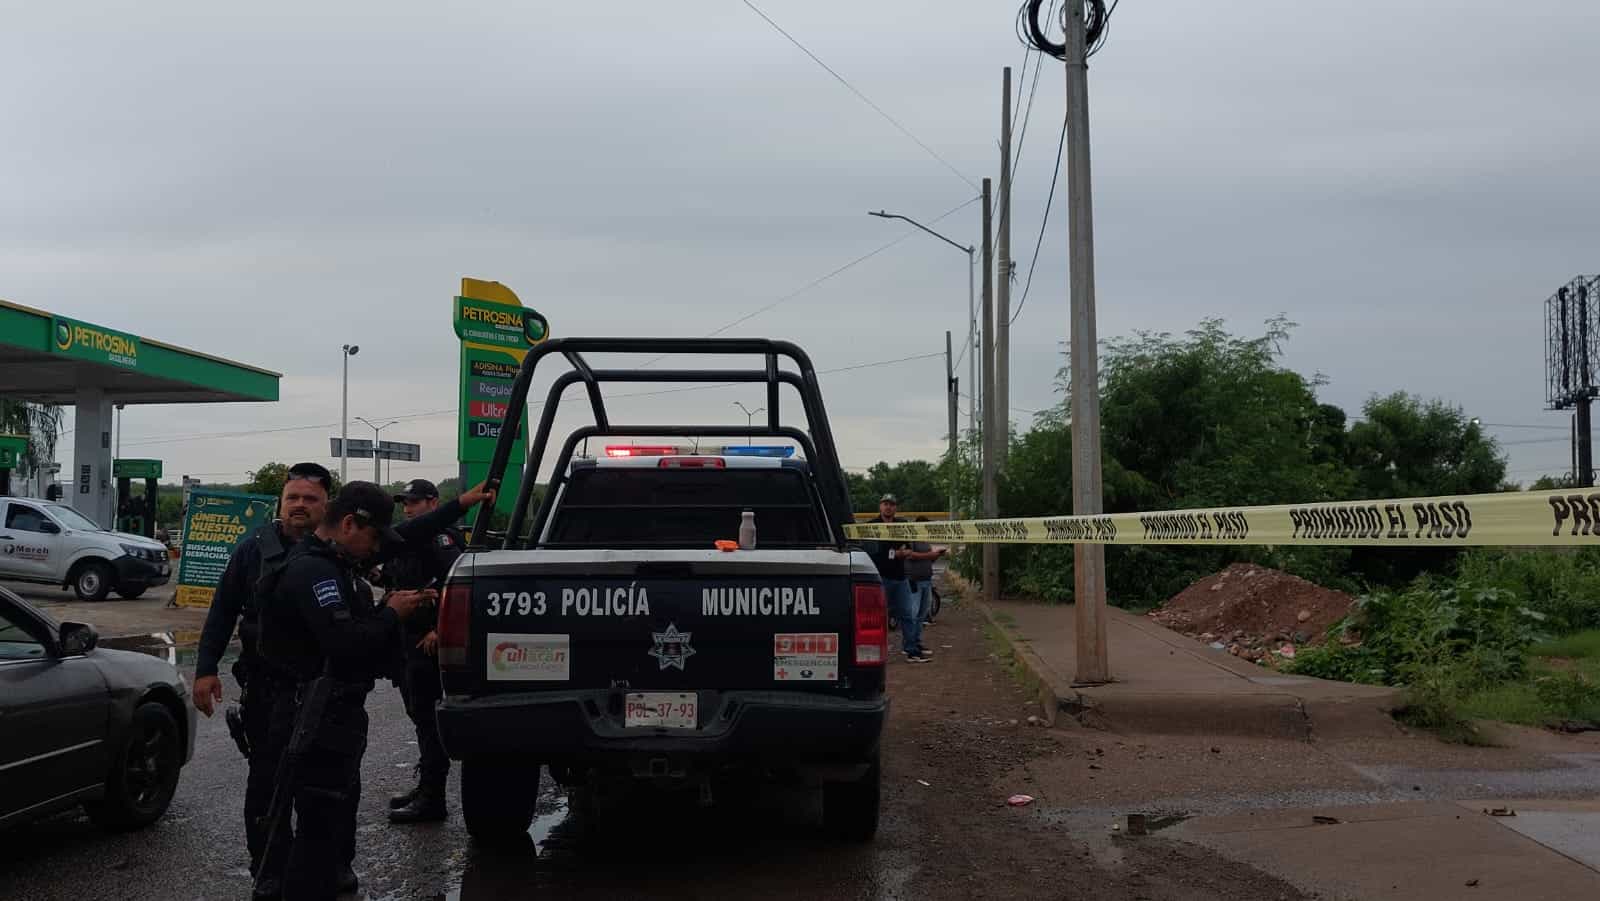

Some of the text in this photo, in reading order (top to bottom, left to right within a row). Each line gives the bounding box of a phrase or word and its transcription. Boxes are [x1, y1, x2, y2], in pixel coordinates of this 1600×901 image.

[463, 306, 523, 327] PETROSINA
[75, 326, 136, 357] PETROSINA
[480, 382, 512, 397] Regula
[478, 423, 502, 437] Dies
[190, 519, 247, 534] NUESTRO
[231, 515, 240, 524] A
[1140, 511, 1249, 540] PROHIBIDO EL PASO
[1289, 501, 1472, 539] PROHIBIDO EL PASO
[188, 531, 238, 544] EQUIPO!
[186, 544, 228, 553] BUSCAMOS
[487, 581, 820, 616] 3793 POLICÍA MUNICIPAL
[780, 637, 833, 652] 911
